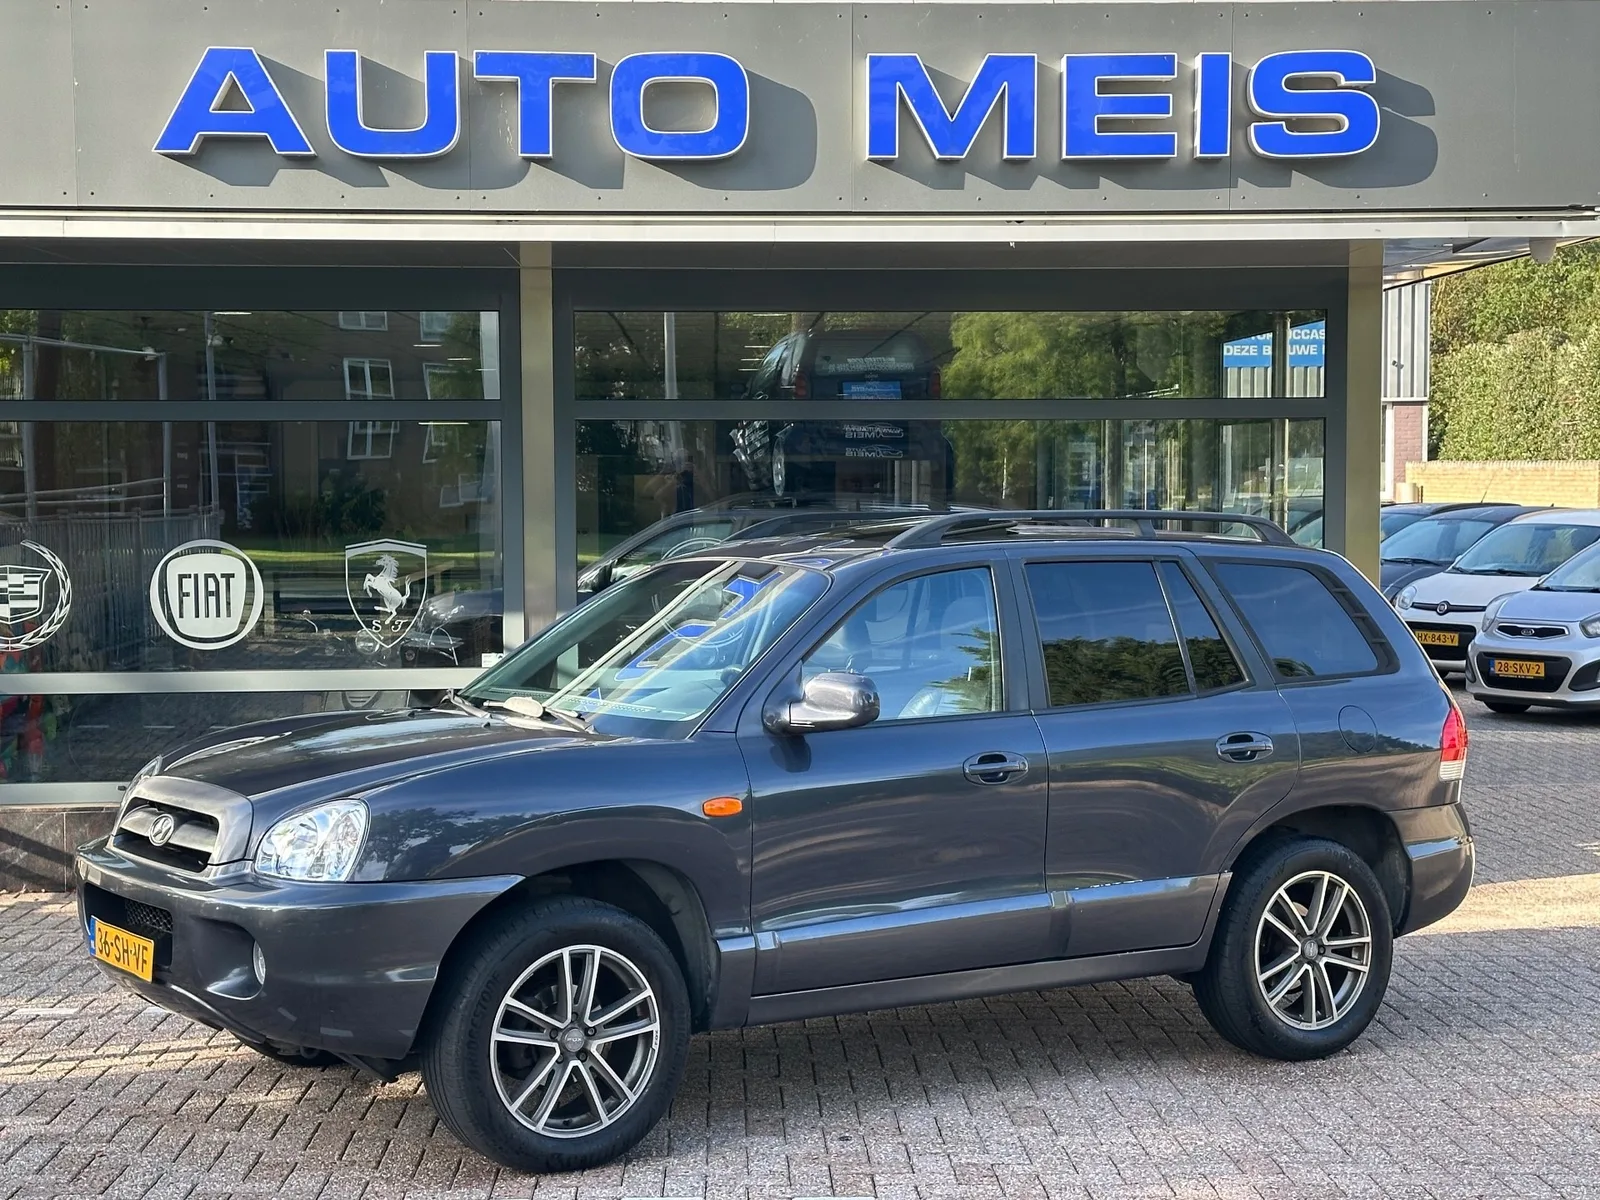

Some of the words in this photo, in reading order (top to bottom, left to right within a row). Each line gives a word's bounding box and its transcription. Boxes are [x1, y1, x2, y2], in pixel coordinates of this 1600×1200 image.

[151, 46, 750, 159] AUTO
[866, 49, 1381, 162] MEIS
[1224, 345, 1258, 356] DEZE
[177, 572, 235, 618] FIAT
[1417, 632, 1456, 644] HX-843-V
[1498, 661, 1540, 675] 28-SKV-2
[97, 927, 148, 973] 36-SH-VF
